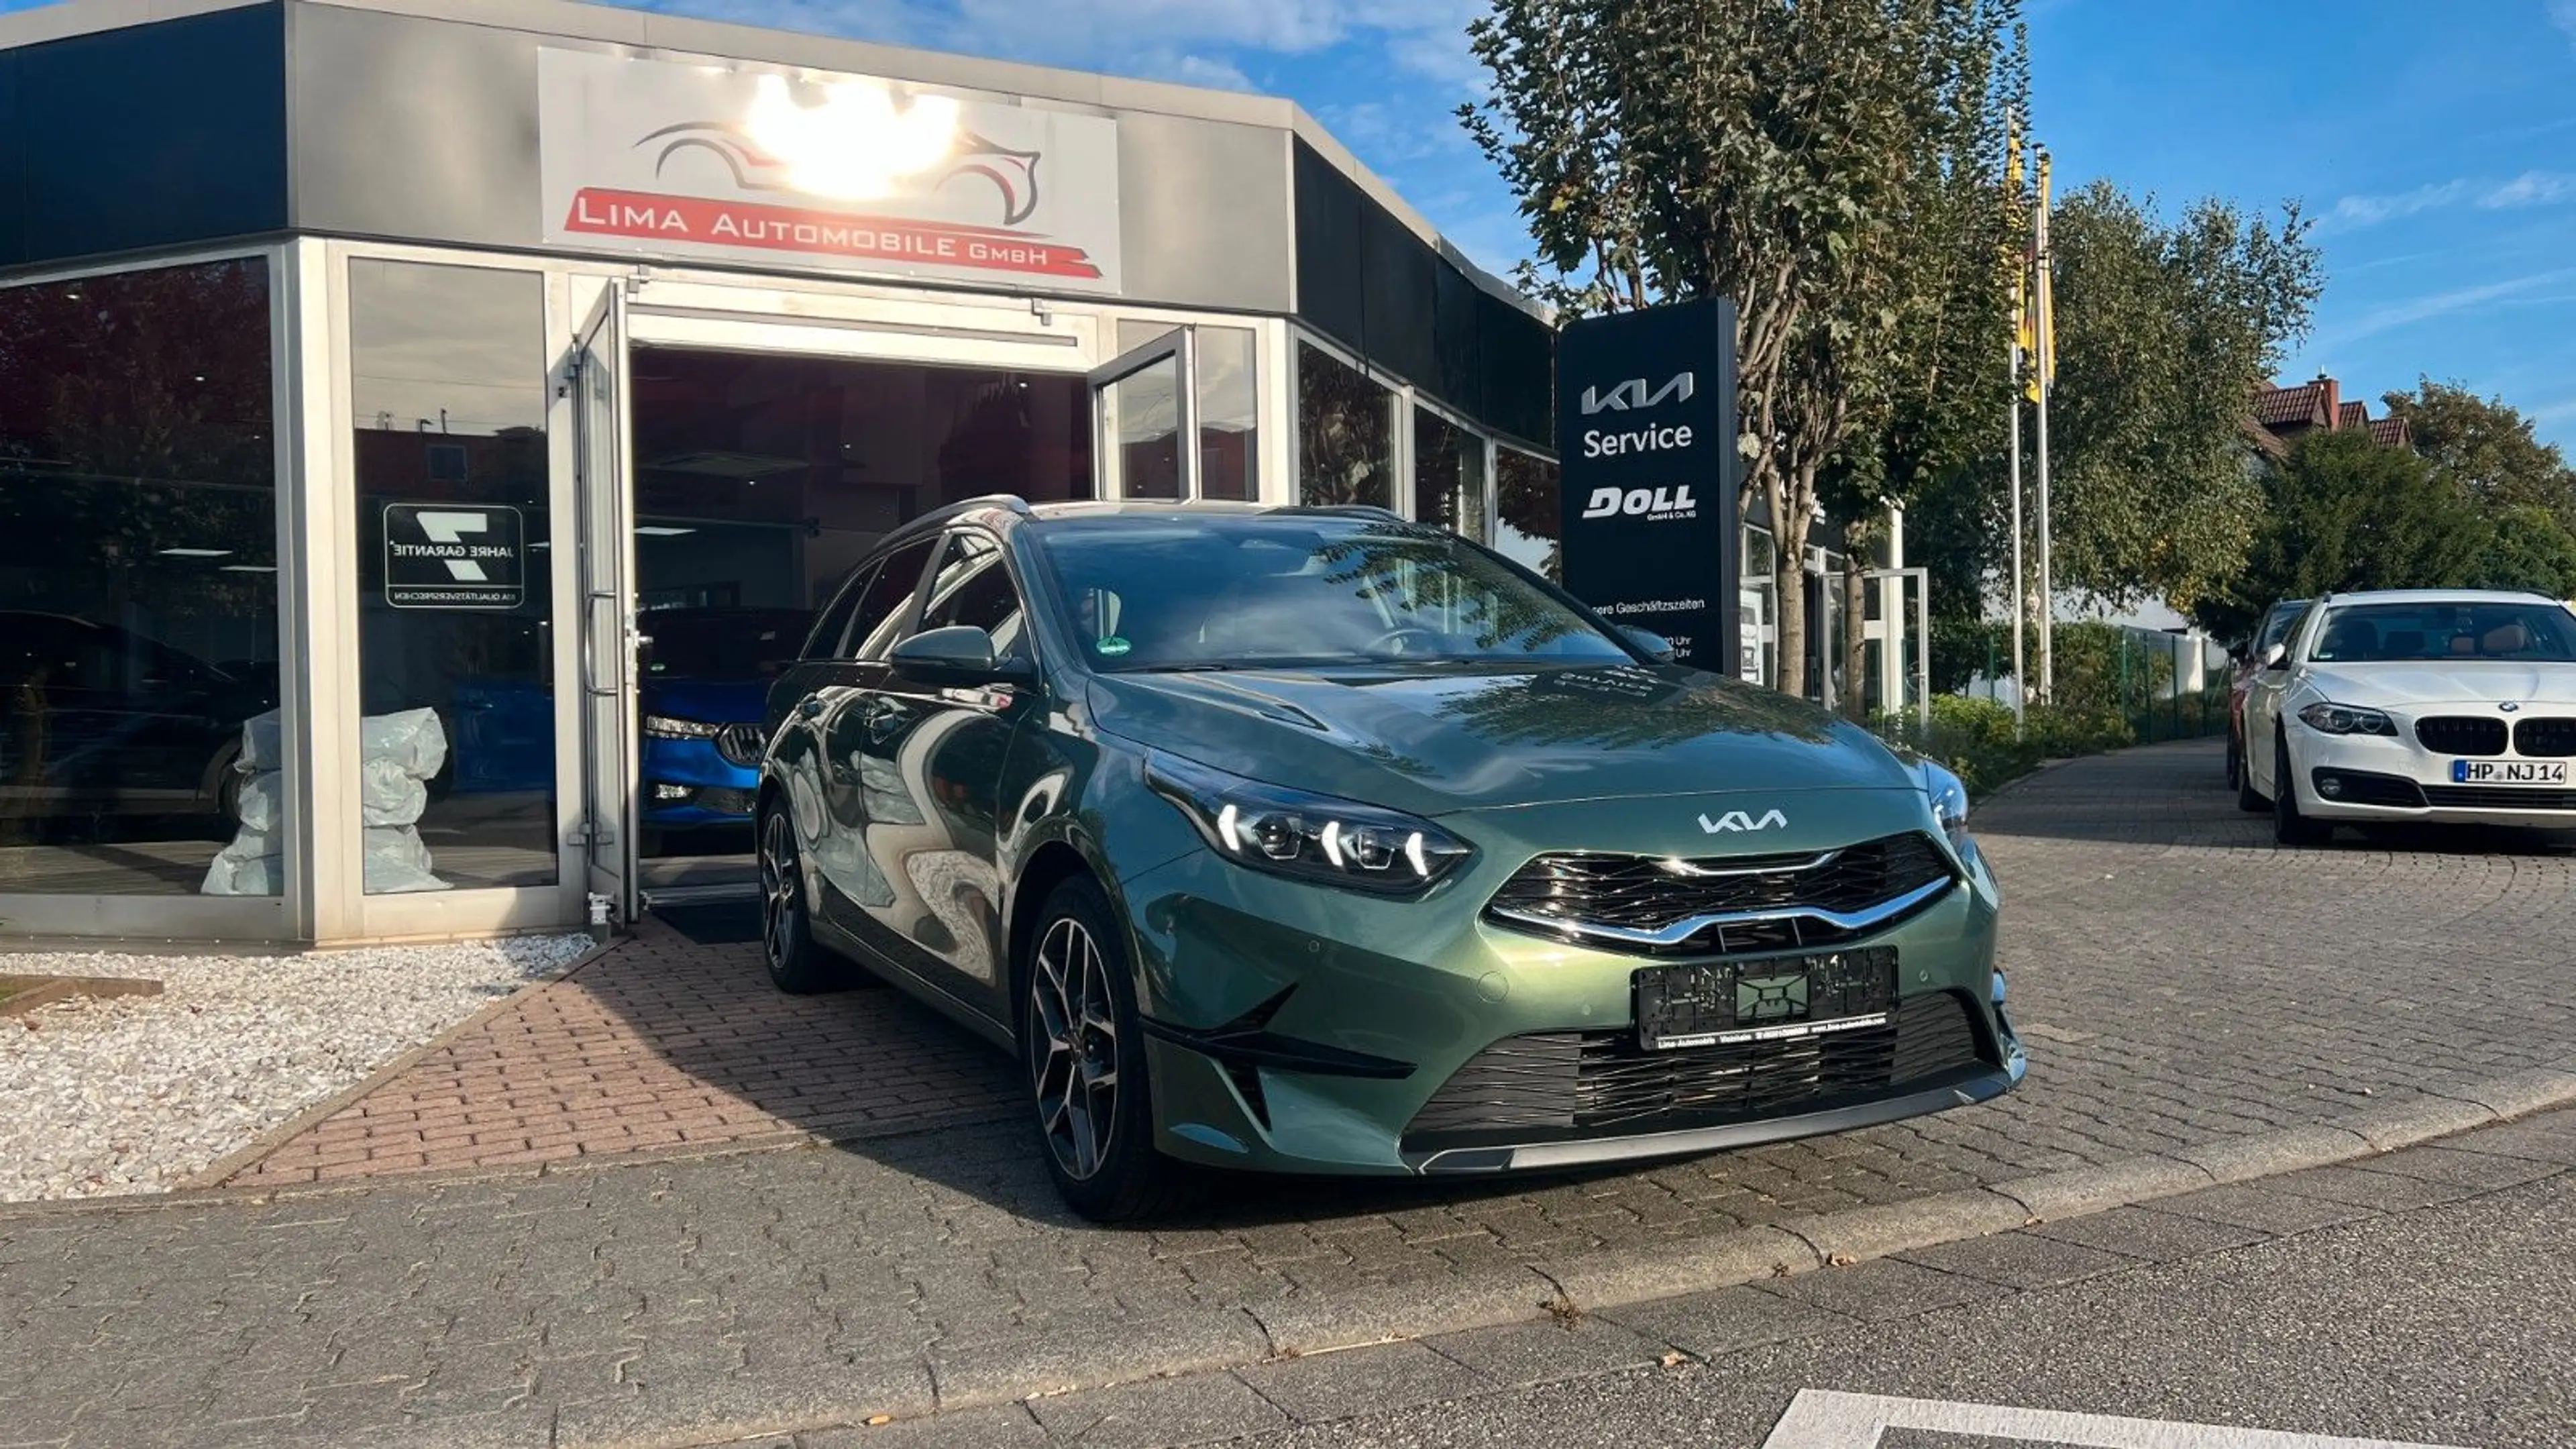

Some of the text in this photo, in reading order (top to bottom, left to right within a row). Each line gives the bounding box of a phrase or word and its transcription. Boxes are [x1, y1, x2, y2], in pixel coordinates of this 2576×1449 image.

[1583, 421, 1693, 458] Service
[1582, 485, 1697, 519] DOLL
[2467, 763, 2493, 780] HP
